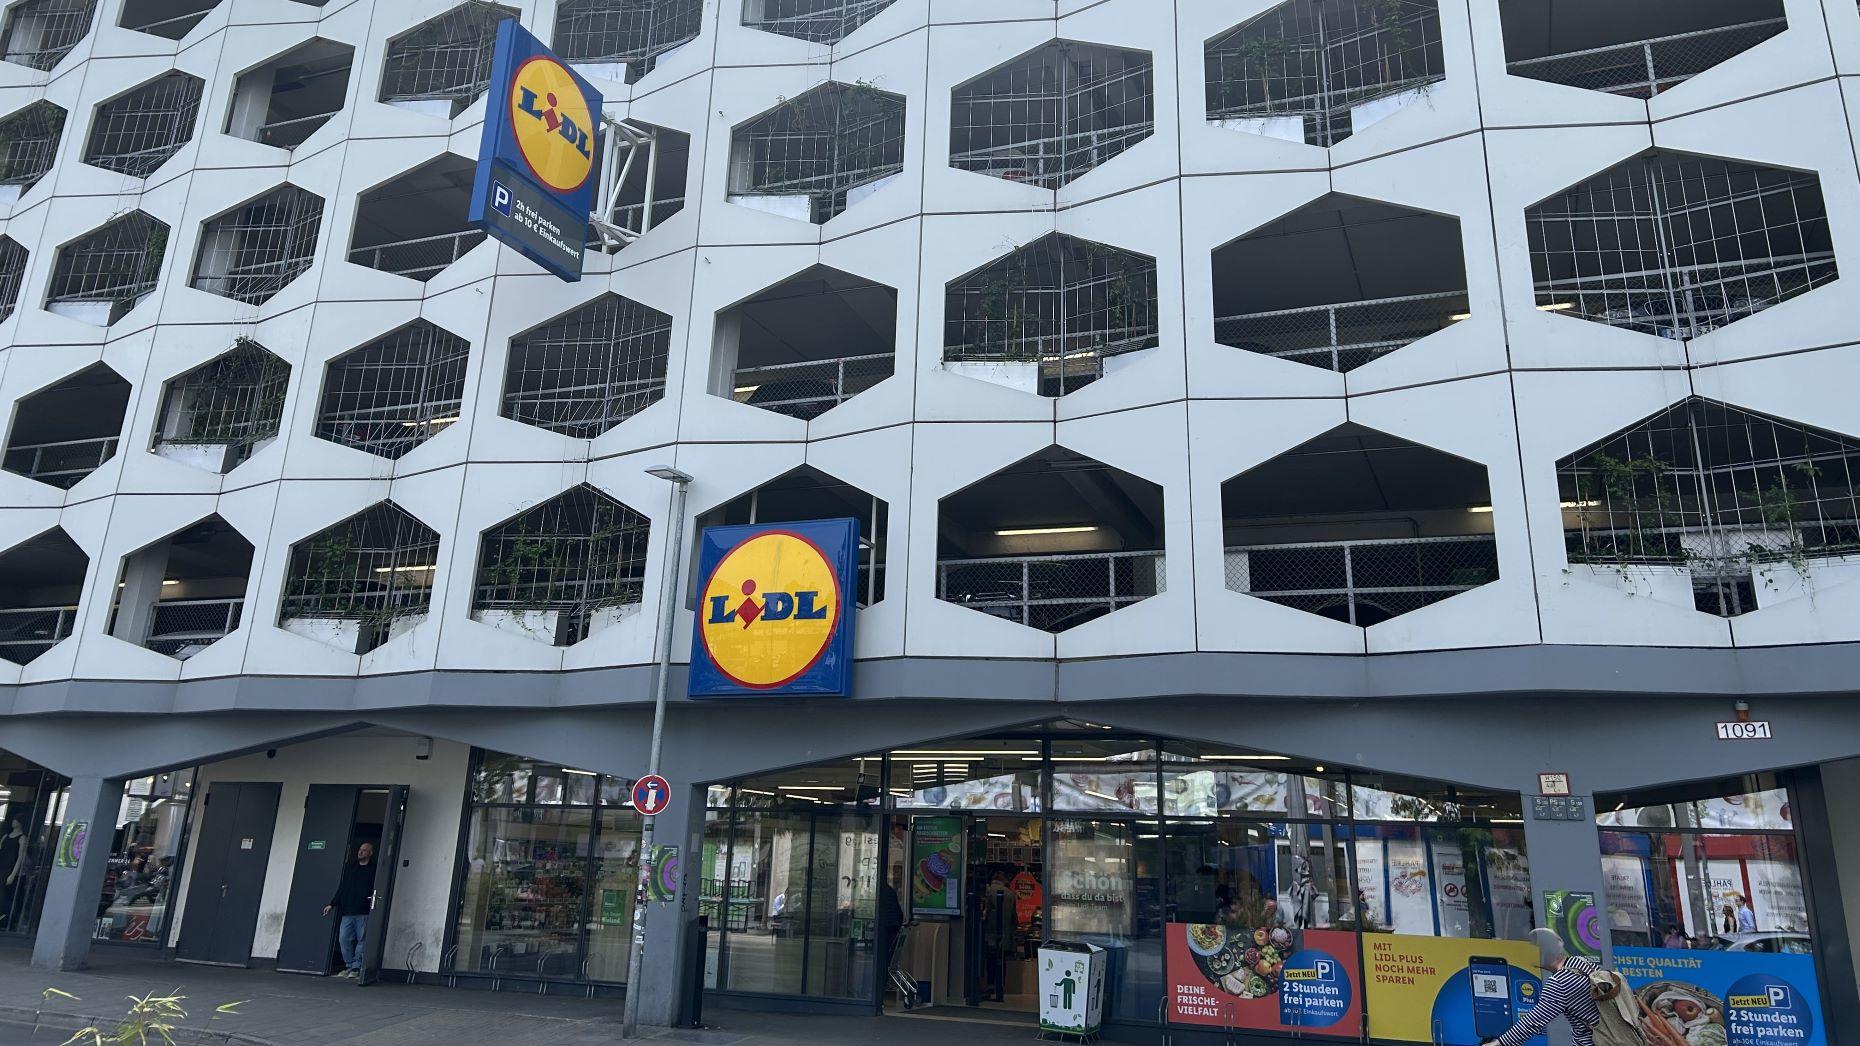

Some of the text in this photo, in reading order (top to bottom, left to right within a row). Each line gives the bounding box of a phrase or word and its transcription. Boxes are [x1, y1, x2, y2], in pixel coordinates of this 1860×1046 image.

[495, 185, 508, 207] P
[516, 200, 560, 236] 2h frei parken
[514, 212, 579, 259] ab 10 € Einkaufswert
[1720, 722, 1767, 738] 1091
[1061, 892, 1080, 900] dass
[1082, 892, 1092, 901] du
[1094, 893, 1105, 901] da
[1373, 942, 1392, 951] MIT
[1374, 953, 1424, 964] LIDL PLUS
[1646, 957, 1702, 969] QUALITÄT
[1317, 962, 1330, 979] P
[1375, 963, 1436, 976] NOCH MEHR
[1621, 967, 1663, 978] BESTEN
[1376, 974, 1415, 985] SPAREN
[1176, 984, 1205, 995] DEINE
[1283, 981, 1339, 995] 2 Stunden
[1177, 995, 1219, 1006] FRISCHE-
[1283, 994, 1344, 1008] frei parken
[1731, 997, 1768, 1006] Jetzt NEU
[1769, 987, 1784, 1006] P
[1177, 1005, 1219, 1016] VIELFALT
[1303, 1009, 1339, 1017] Einkaufswert
[1729, 1009, 1797, 1024] 2 Stunden
[1731, 1023, 1804, 1038] frei parken
[1755, 1038, 1798, 1046] Einkaufswert
